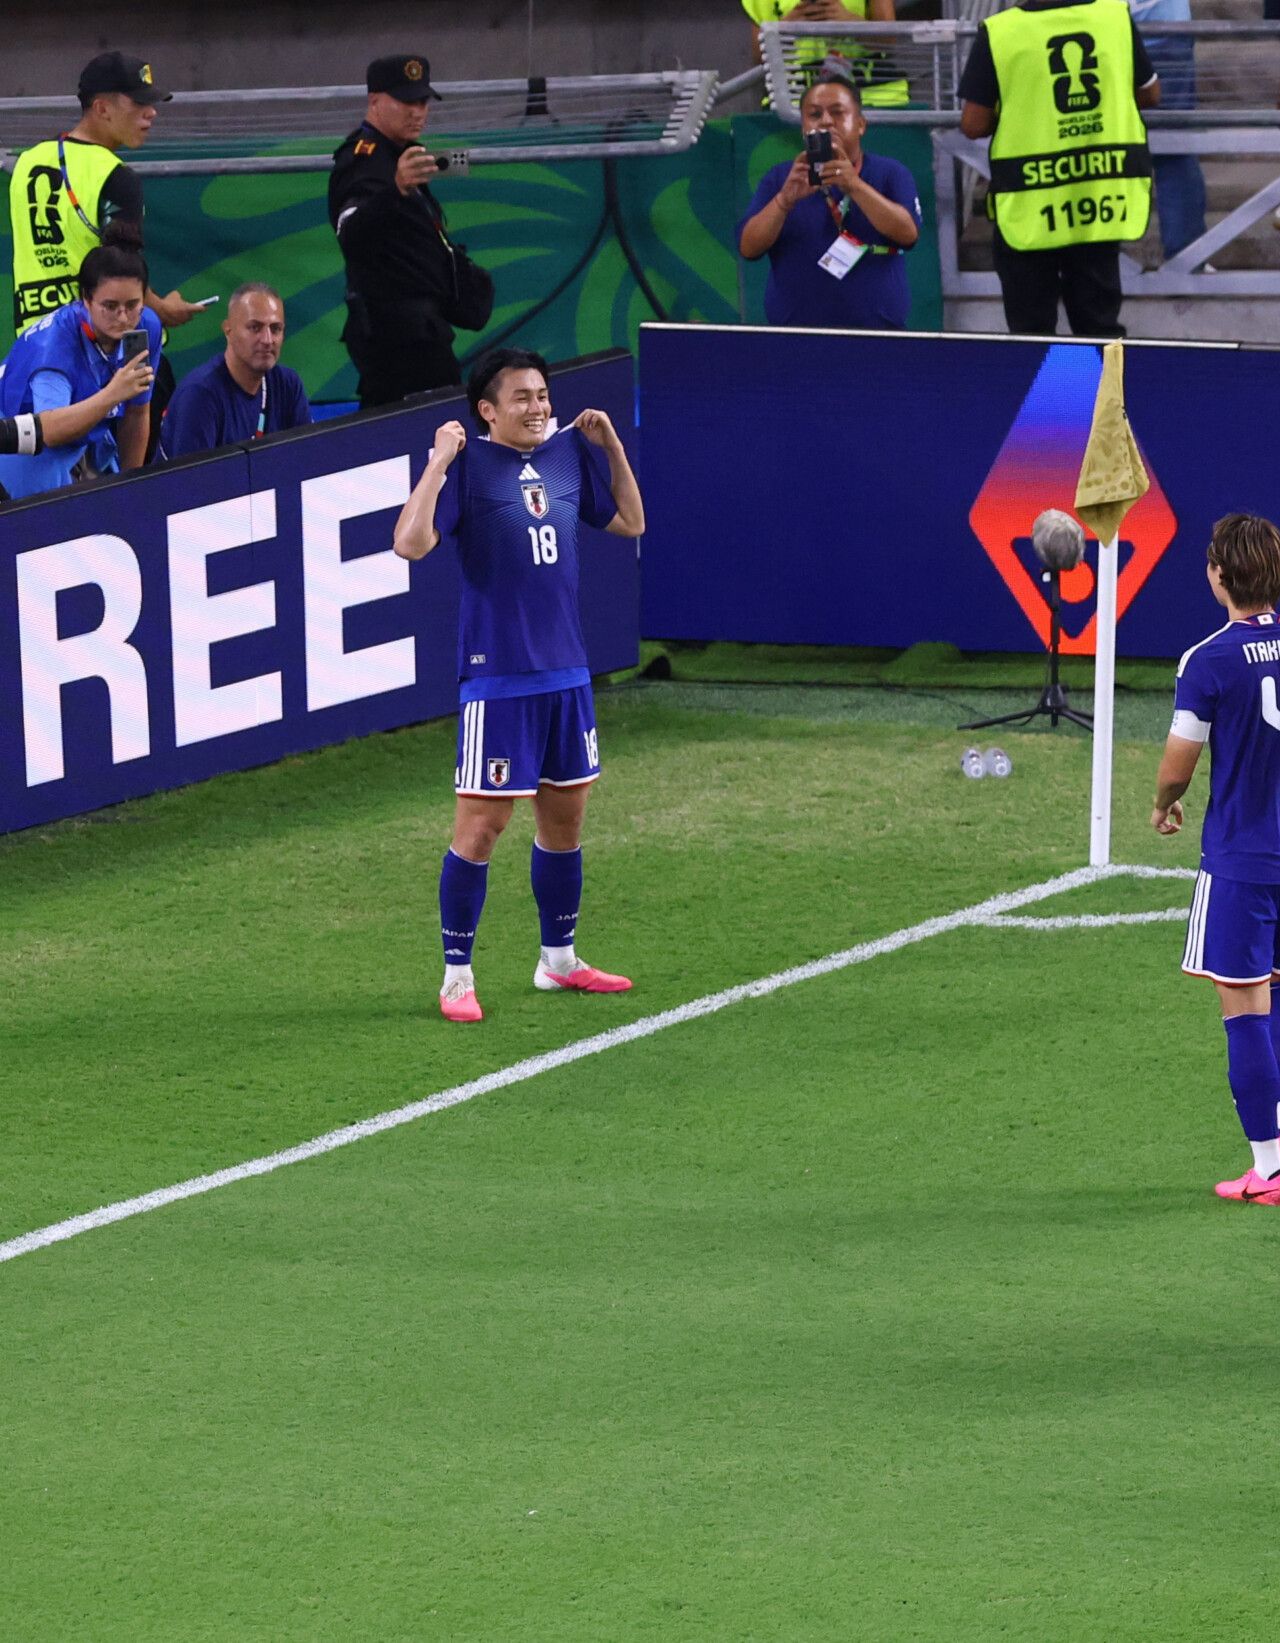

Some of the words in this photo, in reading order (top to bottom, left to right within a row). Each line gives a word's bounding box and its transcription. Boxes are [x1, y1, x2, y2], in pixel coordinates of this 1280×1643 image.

[528, 525, 558, 565] 18
[16, 447, 448, 788] REE
[583, 727, 600, 770] 18
